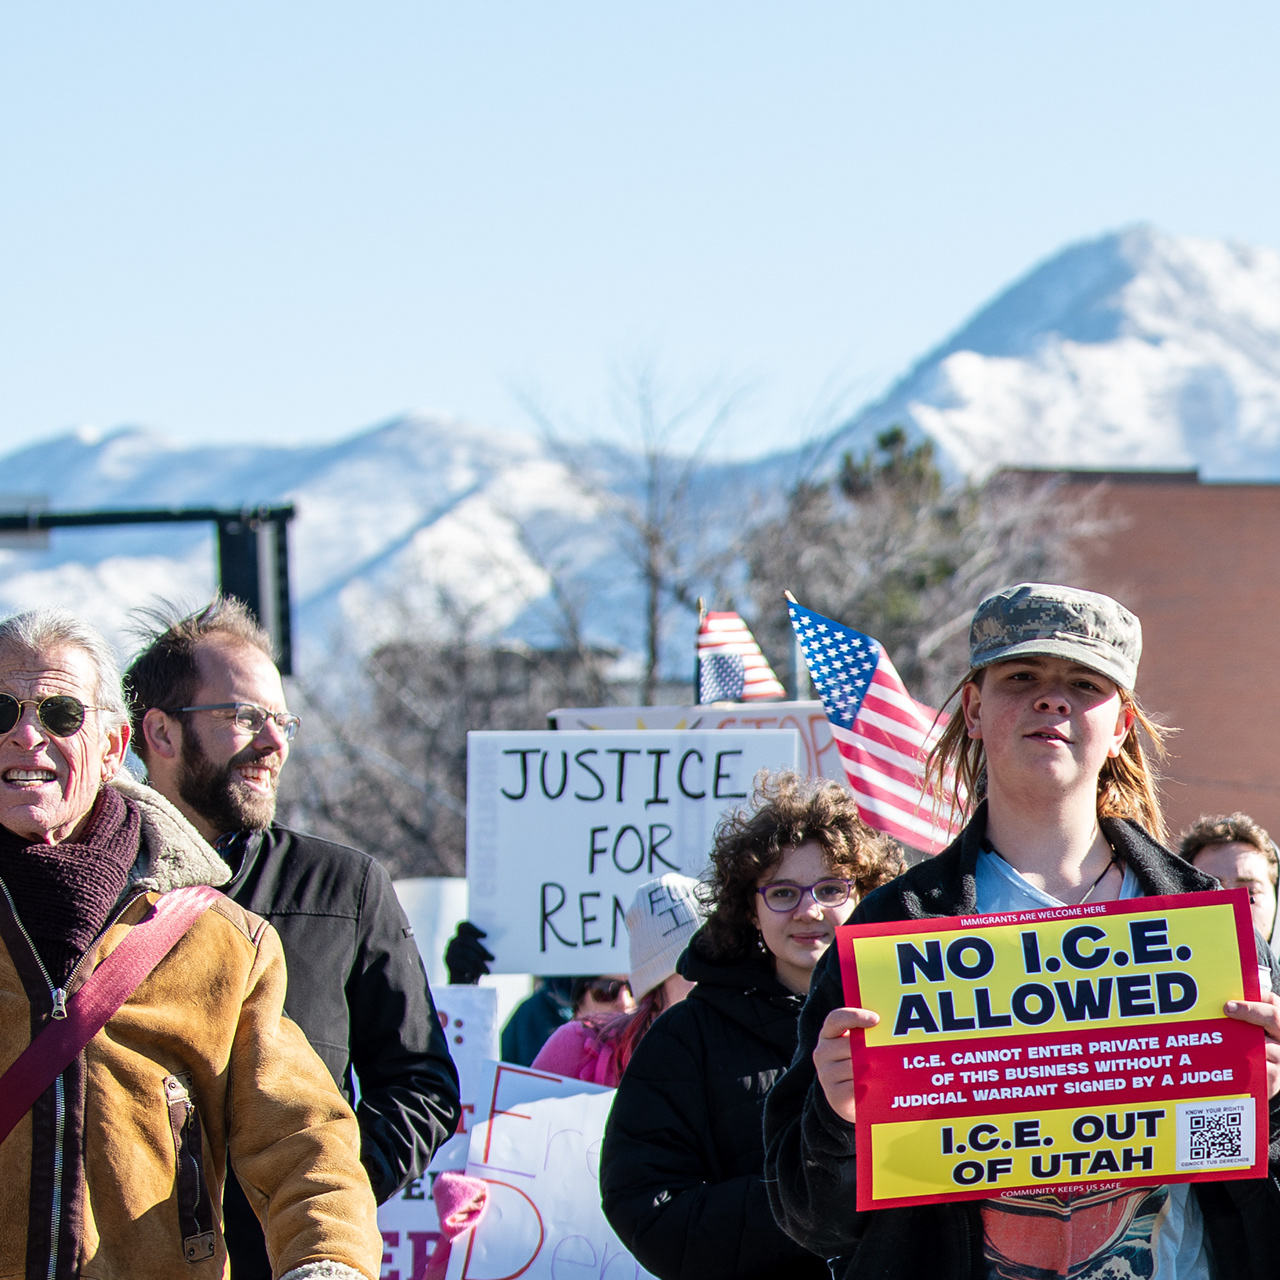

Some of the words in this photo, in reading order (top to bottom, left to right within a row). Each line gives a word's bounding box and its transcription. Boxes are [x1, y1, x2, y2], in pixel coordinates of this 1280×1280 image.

[501, 749, 747, 810] JUSTICE
[588, 823, 682, 875] FOR
[960, 915, 1018, 926] IMMIGRANTS
[1019, 912, 1036, 921] ARE
[1038, 908, 1082, 919] WELCOME
[1084, 905, 1107, 914] HERE
[896, 935, 995, 985] NO
[1020, 918, 1192, 974] I.C.E.
[893, 971, 1198, 1036] ALLOWED
[903, 1055, 946, 1069] I.C.E.
[951, 1048, 1022, 1065] CANNOT
[1028, 1043, 1083, 1059] ENTER
[1088, 1037, 1159, 1054] PRIVATE
[1165, 1031, 1223, 1048] AREAS
[931, 1073, 954, 1086] OF
[960, 1069, 999, 1084] THIS
[1005, 1062, 1089, 1081] BUSINESS
[1094, 1055, 1173, 1073] WITHOUT
[1179, 1053, 1192, 1066] A
[891, 1091, 967, 1108] JUDICIAL
[972, 1083, 1058, 1101] WARRANT
[1064, 1078, 1126, 1094] SIGNED
[1132, 1075, 1155, 1089] BY
[1161, 1074, 1174, 1086] A
[1180, 1069, 1233, 1085] JUDGE
[941, 1119, 1054, 1155] I.C.E.
[1072, 1109, 1166, 1143] OUT
[952, 1157, 1013, 1186] OF
[1031, 1146, 1153, 1179] UTAH
[1000, 1186, 1056, 1198] COMMUNITY
[1058, 1184, 1084, 1194] KEEPS
[1086, 1184, 1099, 1192] US
[1100, 1182, 1121, 1191] SAFE
